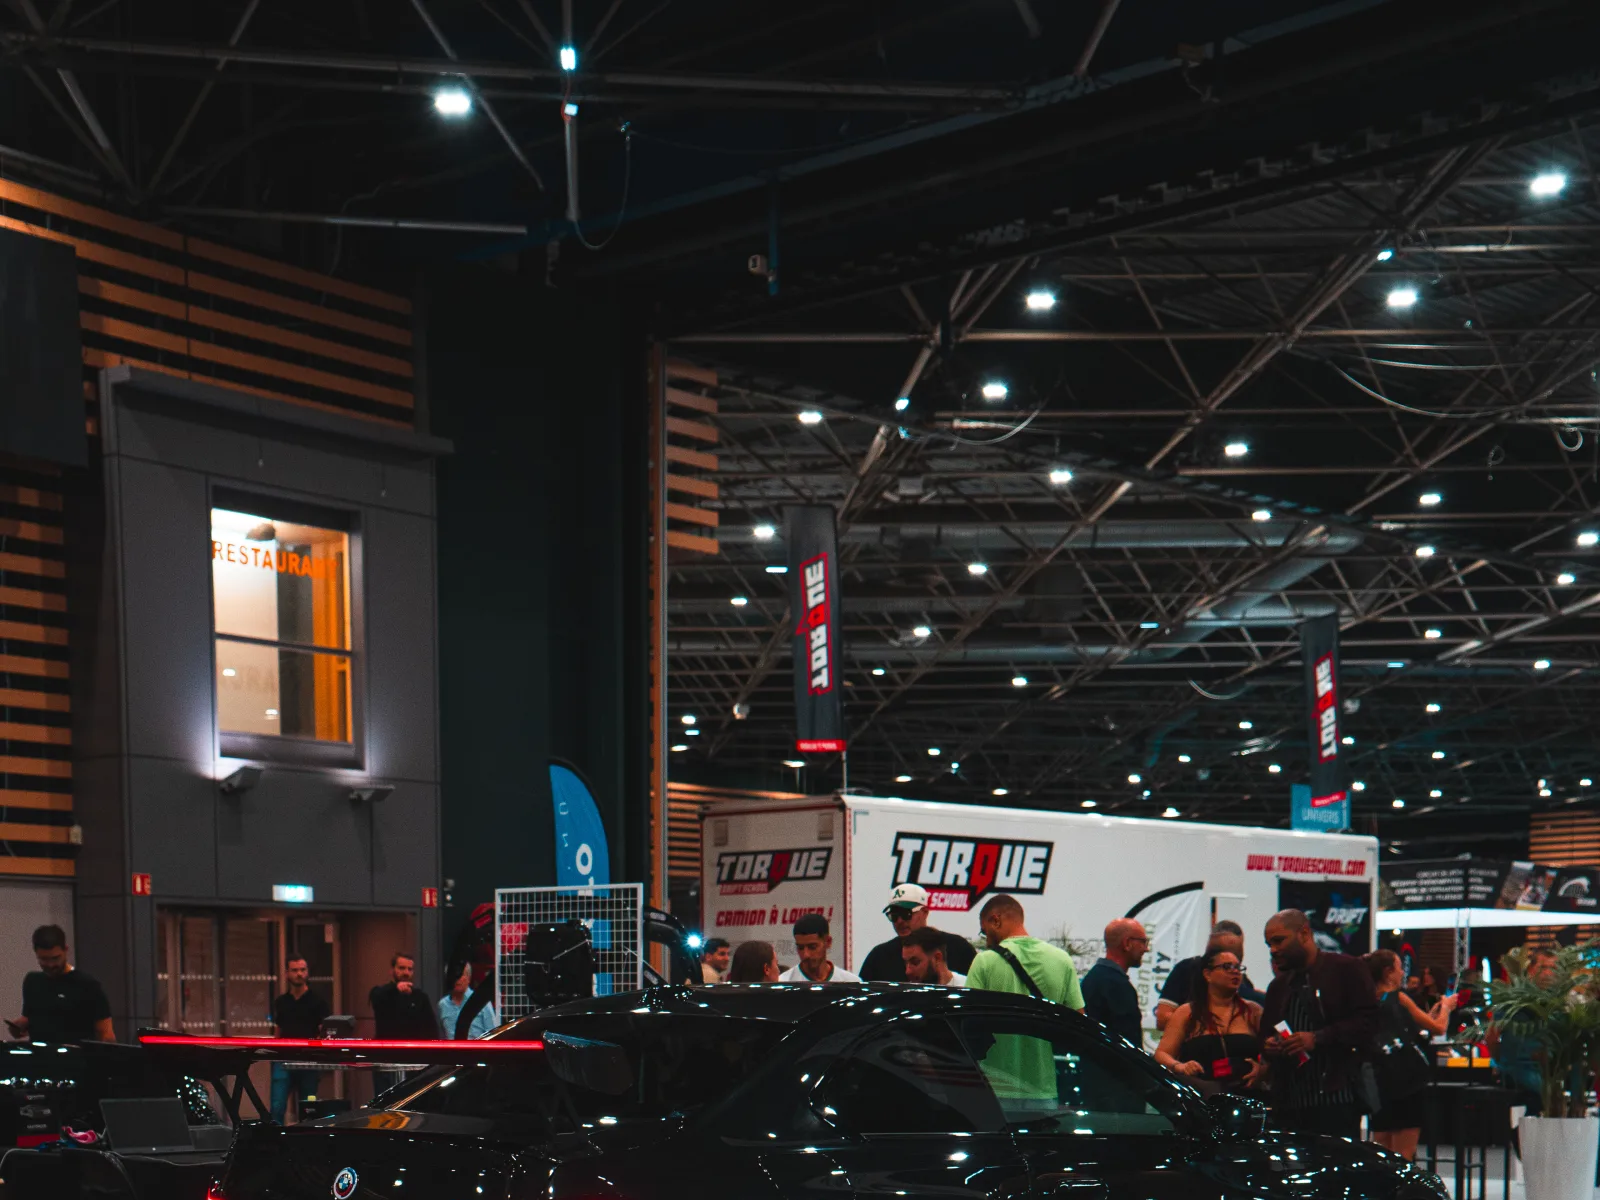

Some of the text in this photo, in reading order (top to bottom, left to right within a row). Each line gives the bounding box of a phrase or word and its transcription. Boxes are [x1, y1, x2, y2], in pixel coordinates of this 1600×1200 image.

[719, 850, 829, 883] TORQUE
[895, 837, 1050, 896] TORQUE
[930, 892, 969, 909] SCHOOL
[715, 908, 766, 927] CAMION
